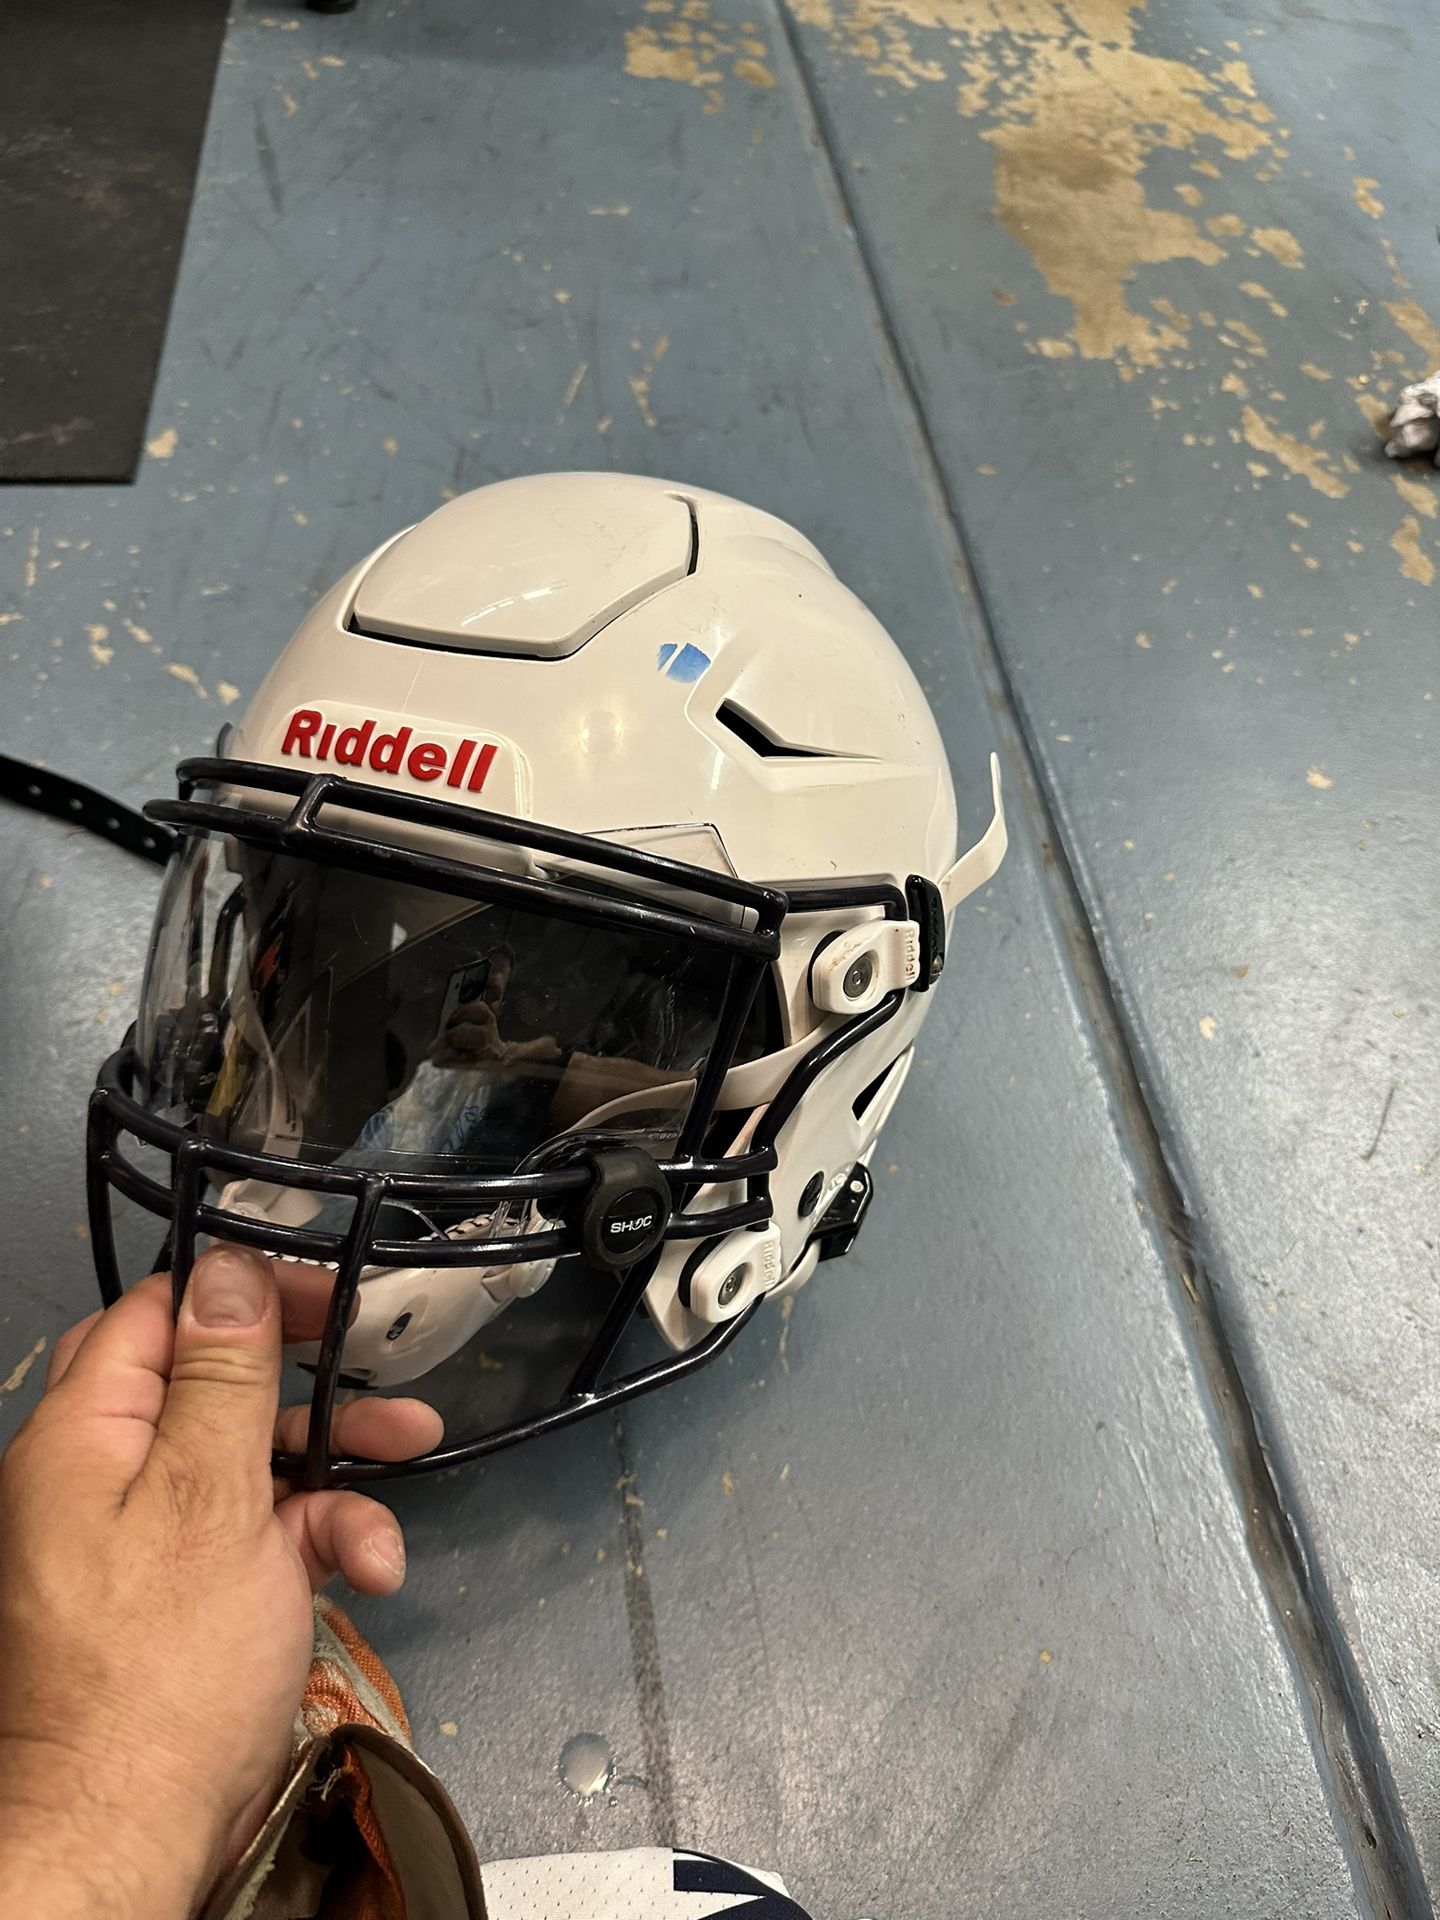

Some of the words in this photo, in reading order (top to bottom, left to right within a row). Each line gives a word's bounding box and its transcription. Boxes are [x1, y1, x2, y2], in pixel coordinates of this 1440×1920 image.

[281, 709, 498, 793] Riddell
[905, 928, 916, 981] Riddell
[610, 1215, 653, 1233] SHOC
[763, 1240, 776, 1288] Riddell
